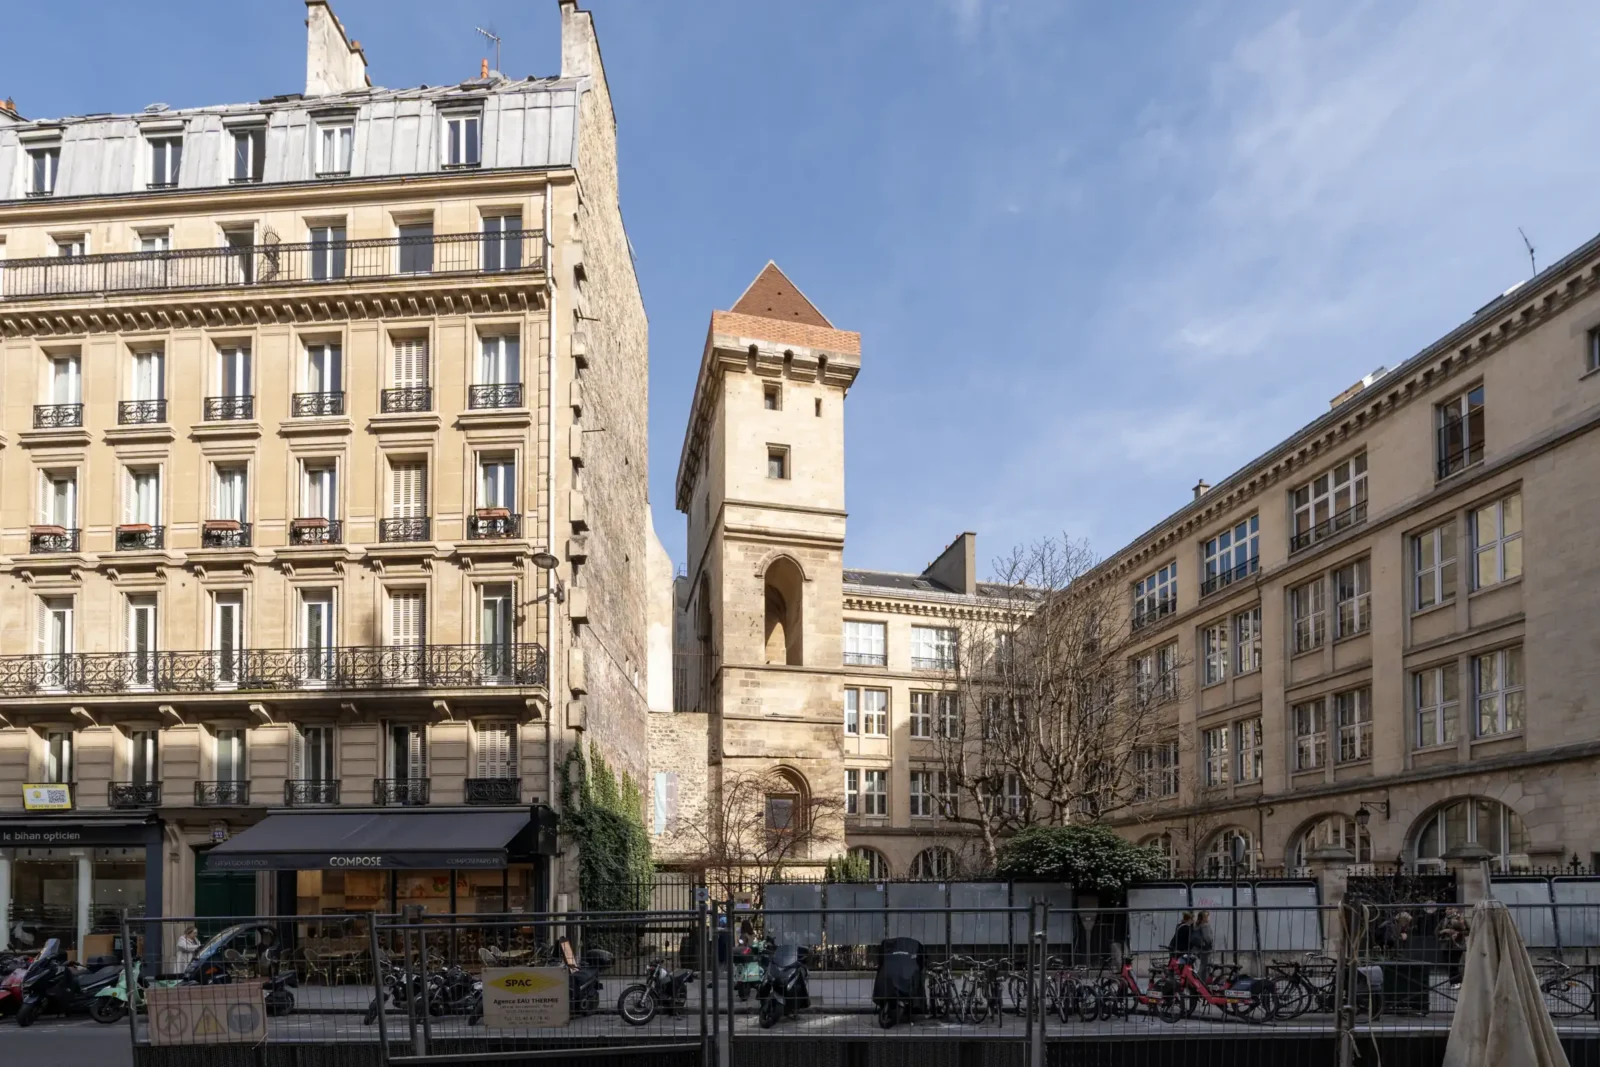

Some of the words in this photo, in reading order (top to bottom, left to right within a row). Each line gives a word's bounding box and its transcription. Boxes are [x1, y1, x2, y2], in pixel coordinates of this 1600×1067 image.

[3, 832, 12, 840] le
[14, 832, 41, 840] bihan
[43, 831, 81, 842] opticien
[329, 856, 382, 867] COMPOSE
[505, 979, 533, 987] SPAC
